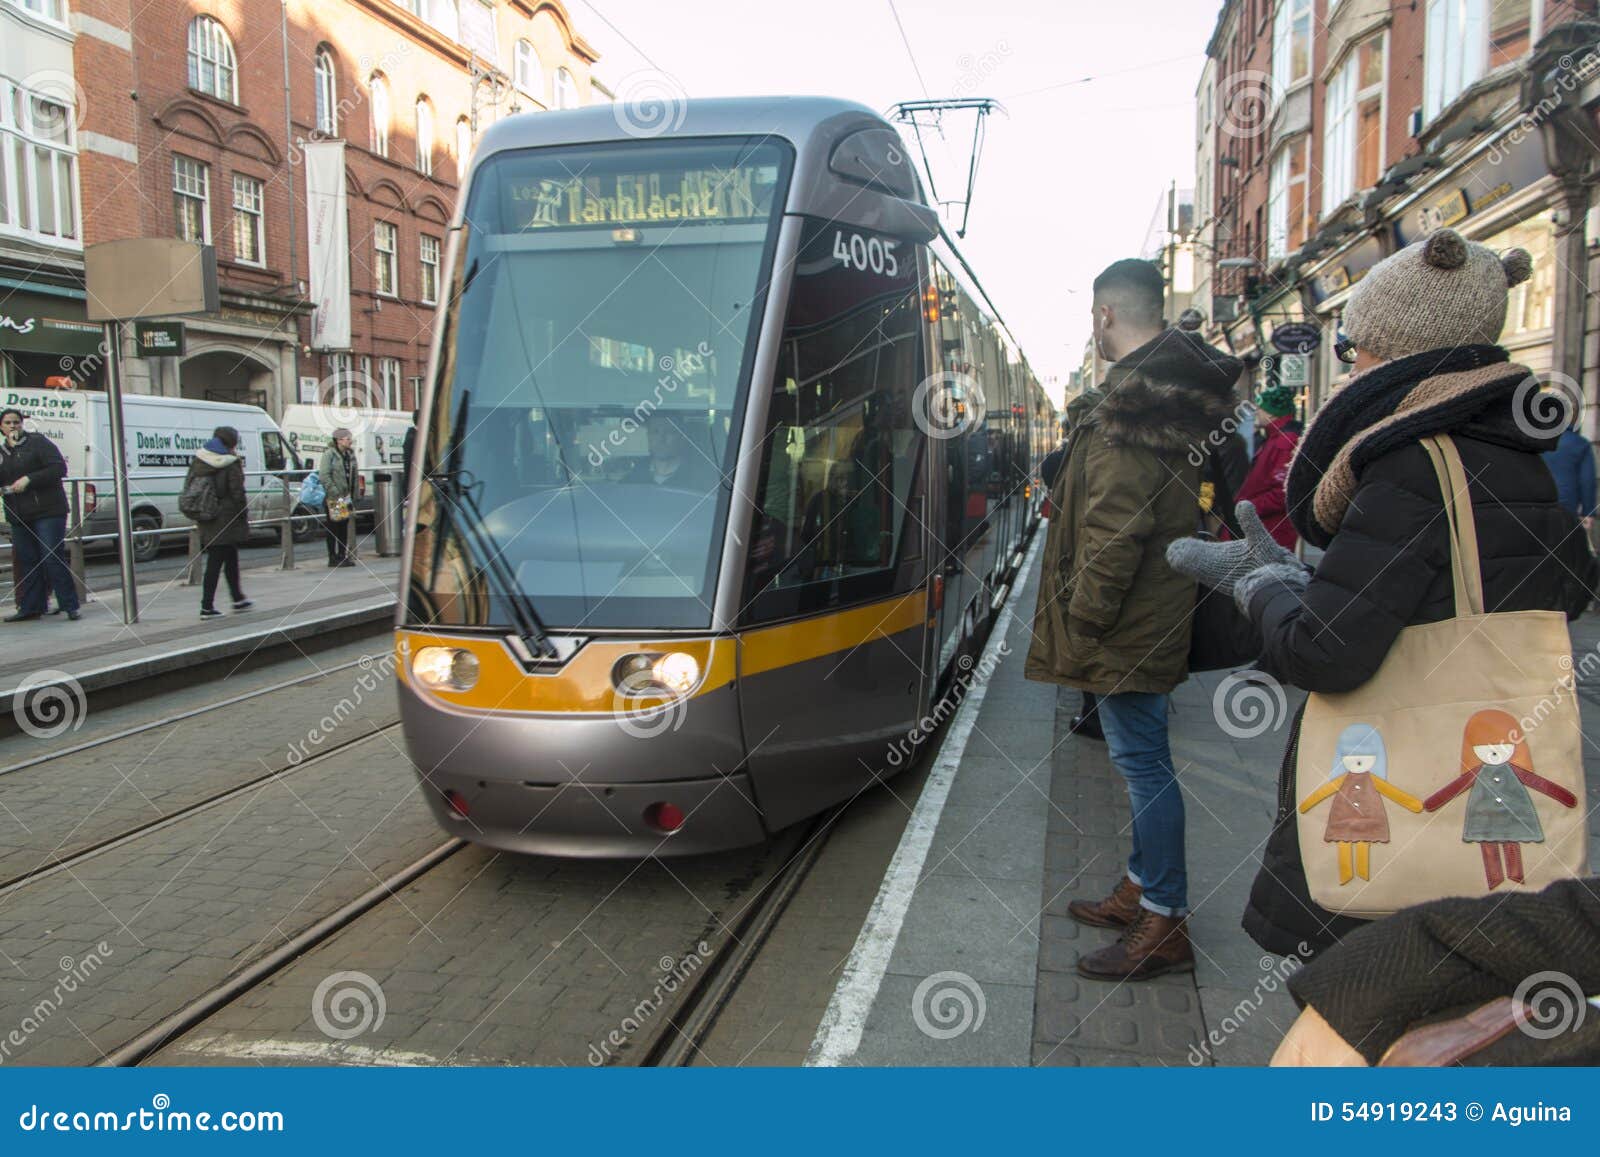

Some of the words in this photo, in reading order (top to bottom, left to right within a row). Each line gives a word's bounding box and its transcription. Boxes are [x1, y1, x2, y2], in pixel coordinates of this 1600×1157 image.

[833, 231, 898, 276] 4005
[0, 314, 35, 334] ns
[6, 393, 77, 409] Donlow
[59, 411, 79, 419] Ltd.
[137, 431, 171, 449] Donlow
